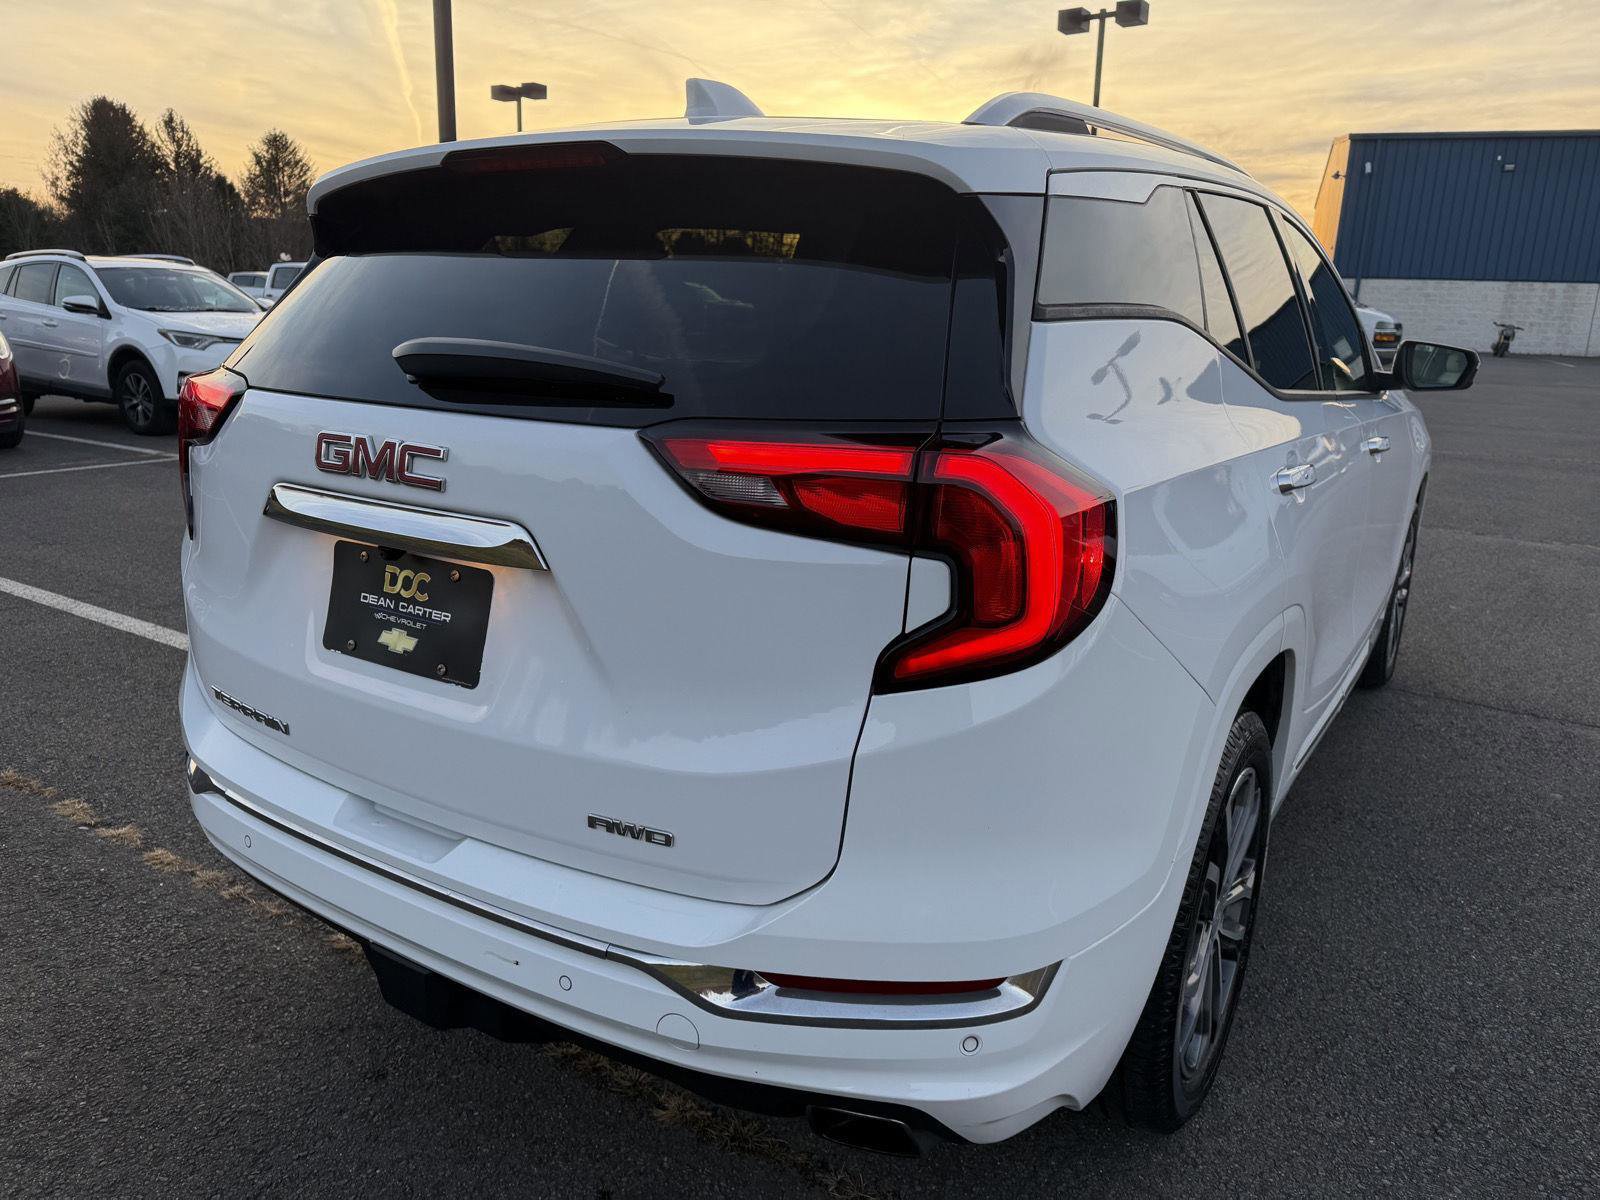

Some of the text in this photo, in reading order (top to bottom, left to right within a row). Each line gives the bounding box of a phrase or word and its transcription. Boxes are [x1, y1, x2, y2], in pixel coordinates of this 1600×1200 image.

[316, 430, 449, 493] GMC
[360, 592, 452, 623] DEAN CARTER
[381, 613, 427, 630] CHEVROLET
[211, 685, 289, 735] TERRAIN
[587, 813, 674, 848] AWD
